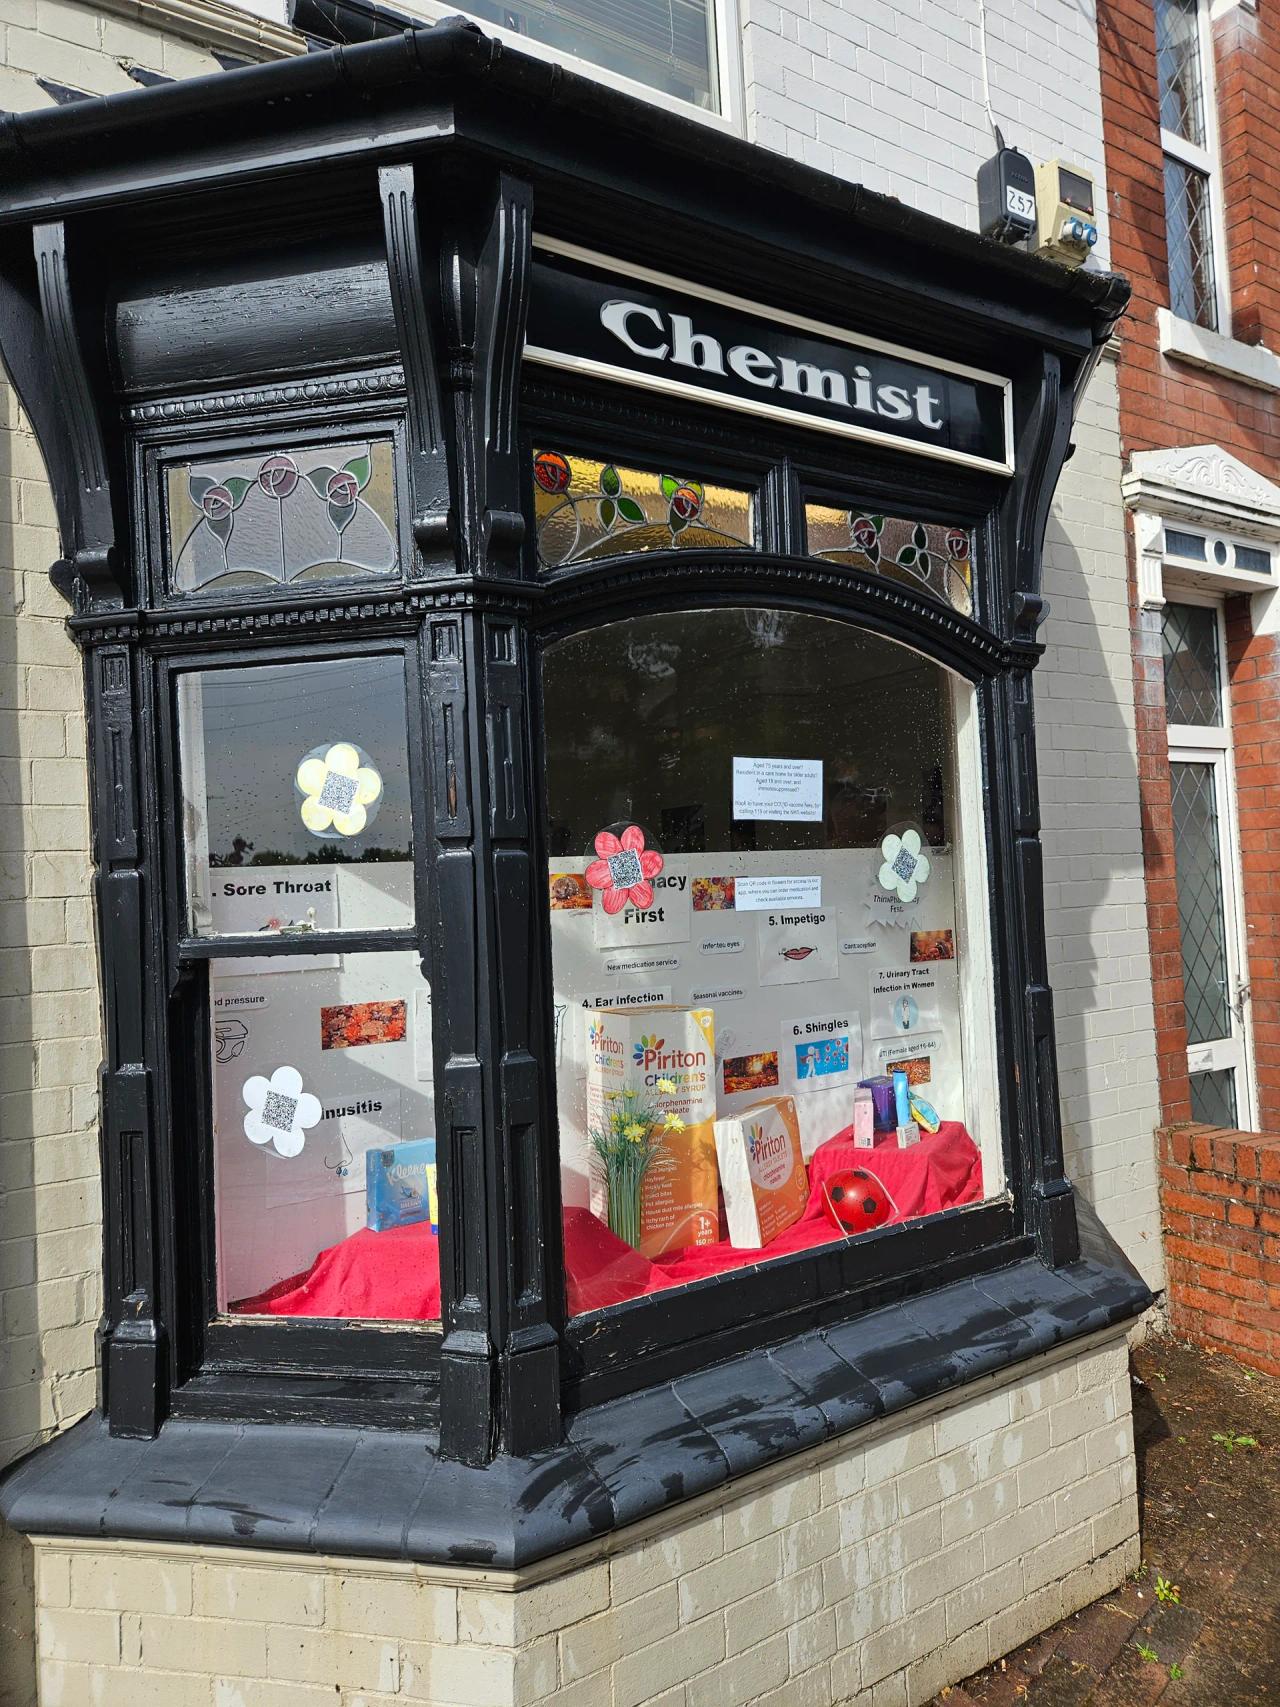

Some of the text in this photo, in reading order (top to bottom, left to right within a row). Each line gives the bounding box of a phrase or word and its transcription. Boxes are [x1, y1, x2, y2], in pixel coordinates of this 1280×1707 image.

[1008, 190, 1033, 214] 257
[600, 299, 944, 430] Chemist
[223, 880, 332, 896] Sore Throat
[625, 907, 664, 924] First
[769, 913, 826, 926] 5. Impetigo
[727, 941, 740, 949] eyes
[607, 959, 677, 972] New medication service
[879, 968, 929, 979] 7. Urinary Tract
[693, 988, 744, 1000] Seasonal vaccines
[873, 980, 935, 994] Infection in Women
[225, 996, 265, 1007] pressure
[582, 993, 664, 1009] 4. Ear Infection
[793, 1019, 849, 1036] 6. Shingles
[594, 1032, 624, 1055] Piriton
[644, 1049, 706, 1071] Piriton
[645, 1072, 706, 1087] Children's
[681, 1084, 706, 1093] SYRUP
[322, 1100, 383, 1120] inusitis
[754, 1134, 786, 1164] Piriton
[388, 1164, 426, 1185] Kleene
[697, 1228, 713, 1238] years
